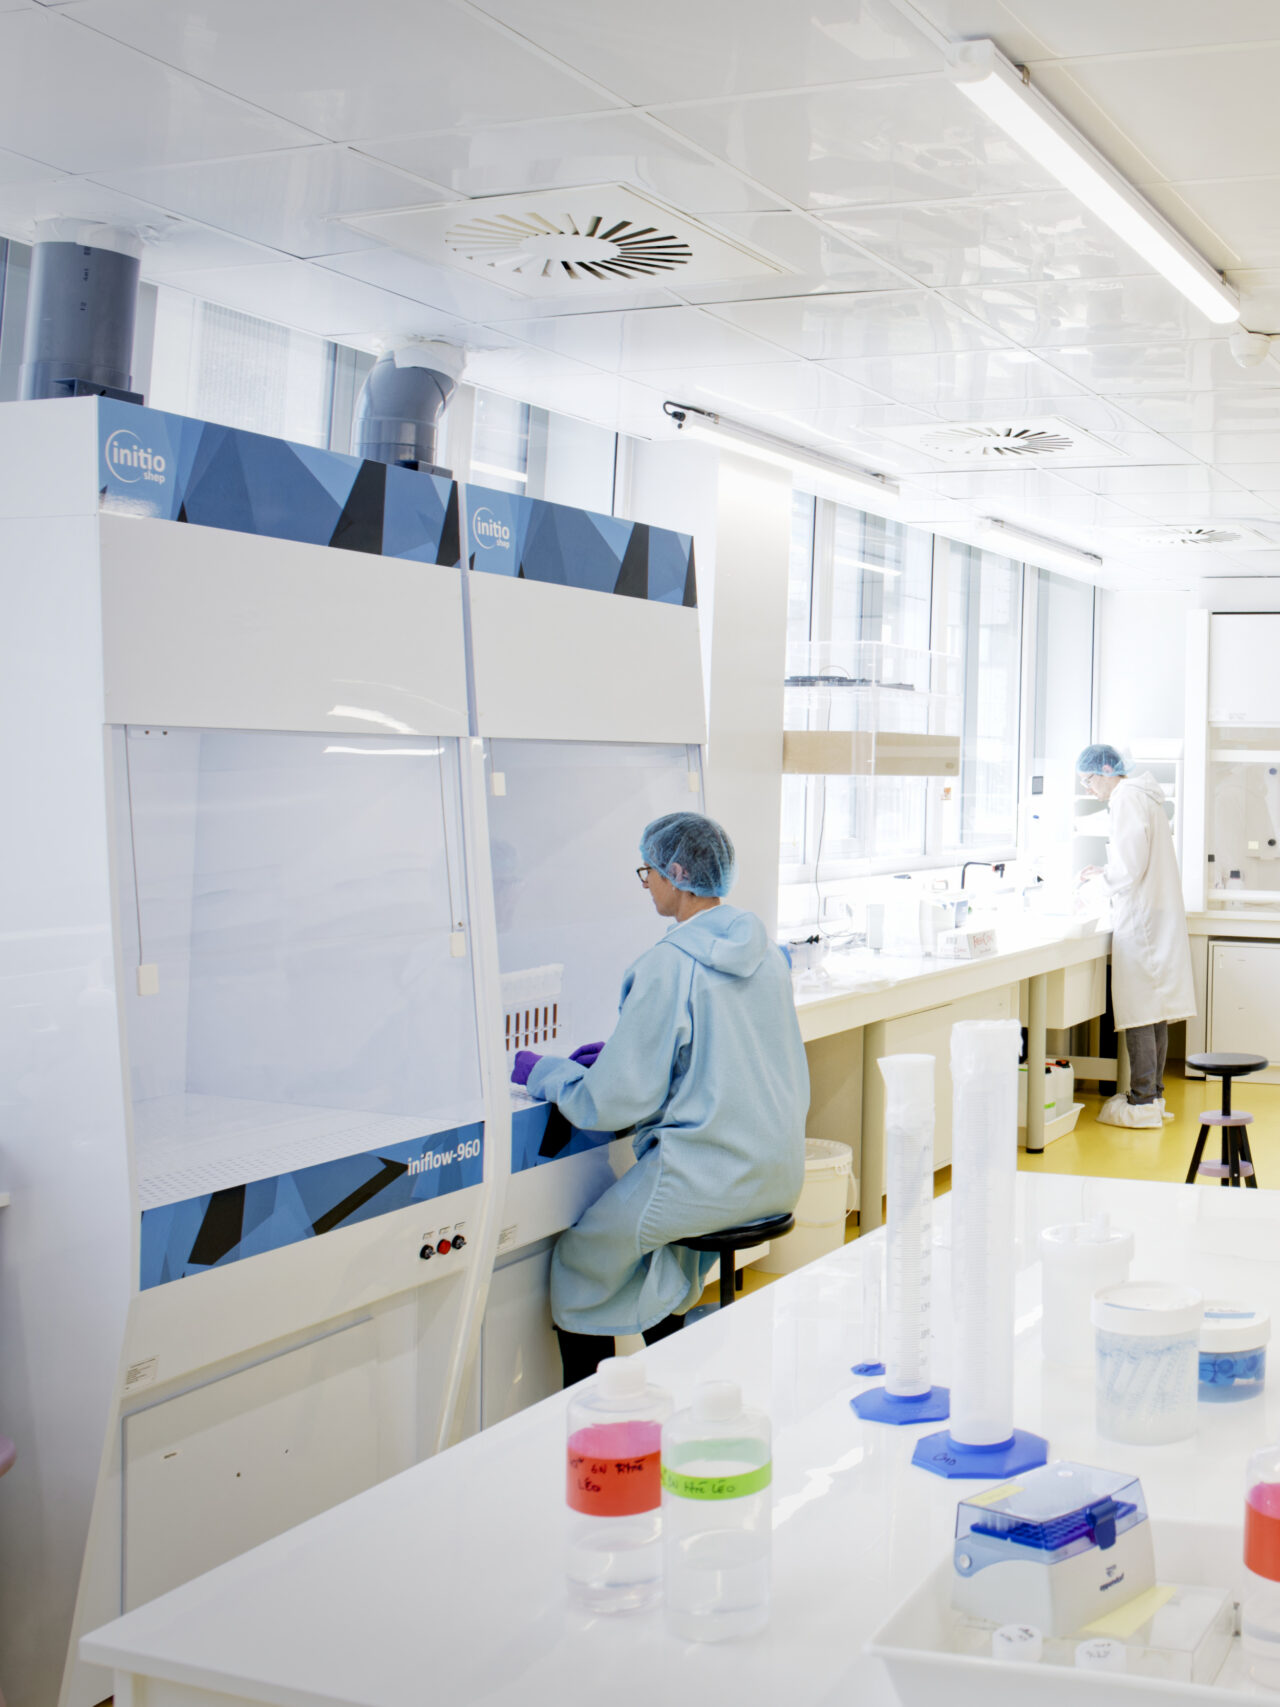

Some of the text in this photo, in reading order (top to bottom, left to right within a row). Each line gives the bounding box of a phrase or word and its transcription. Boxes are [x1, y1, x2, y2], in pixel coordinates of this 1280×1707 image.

[113, 440, 166, 473] initio
[477, 516, 510, 540] initio
[407, 1138, 481, 1176] iniflow-960
